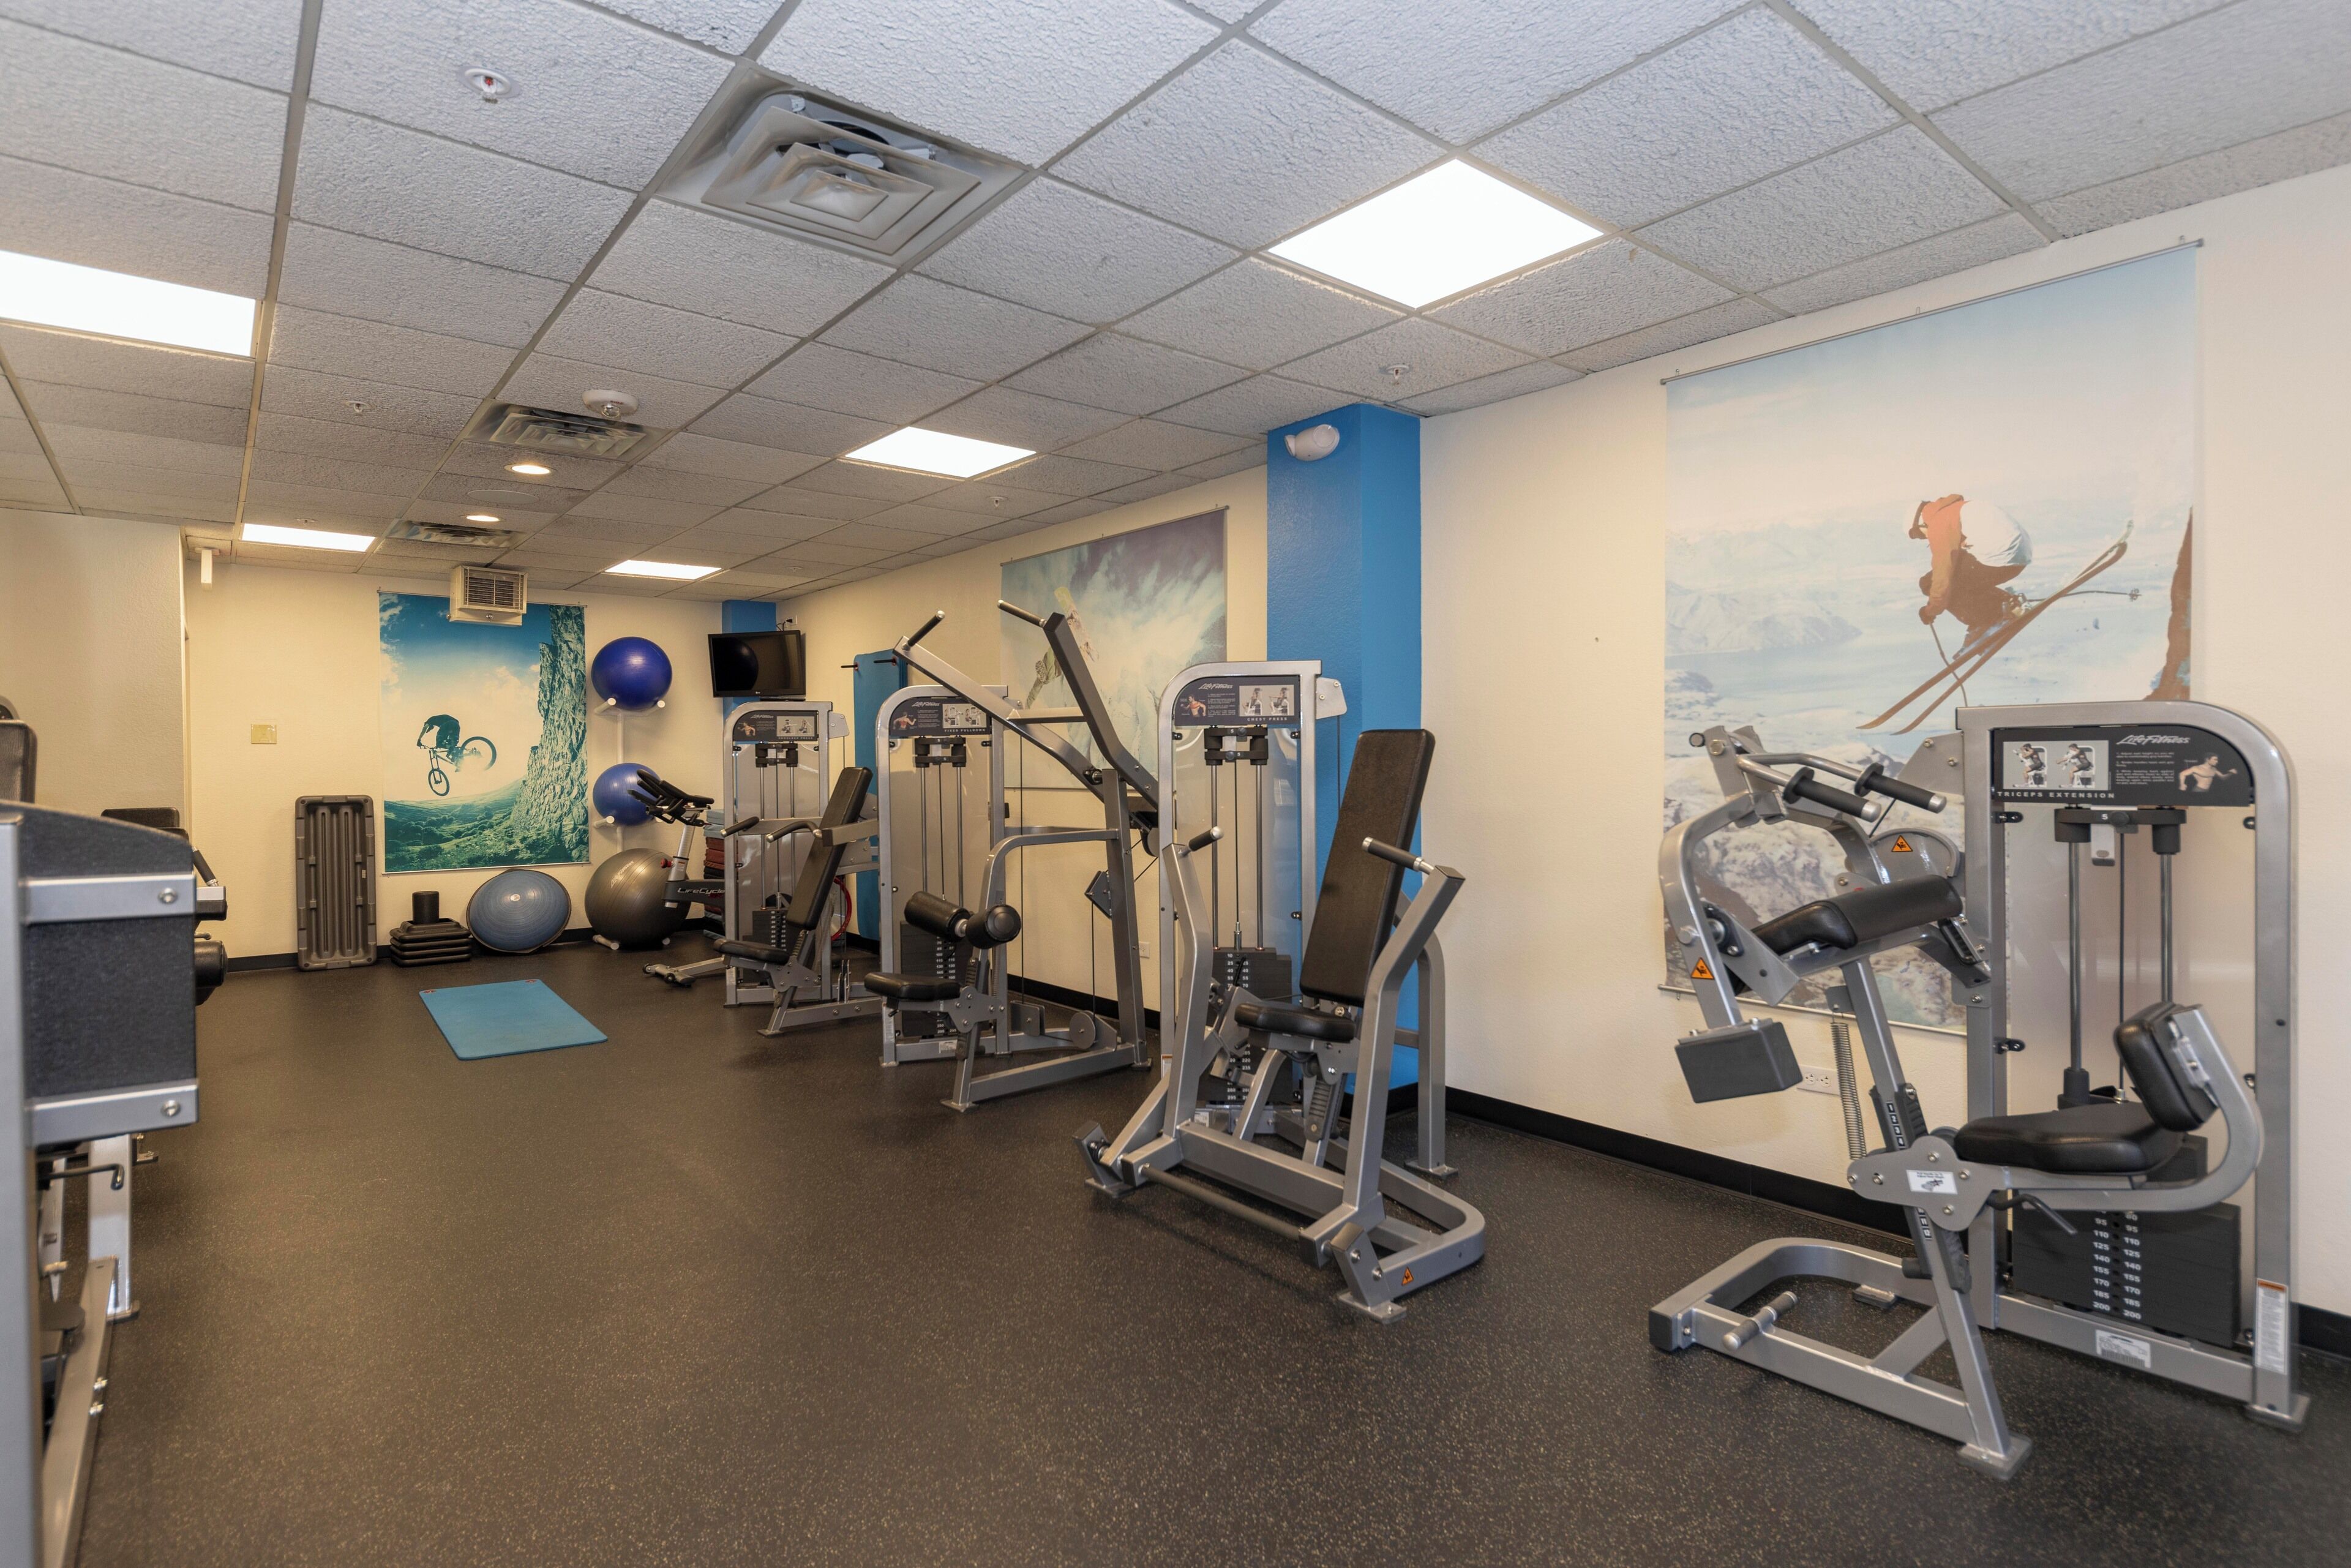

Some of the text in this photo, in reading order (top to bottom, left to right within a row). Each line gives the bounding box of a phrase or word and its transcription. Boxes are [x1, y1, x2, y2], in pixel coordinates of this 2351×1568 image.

[2094, 1217, 2138, 1233] 95 95
[2093, 1229, 2140, 1246] 110 110
[2093, 1242, 2140, 1258] 125 125
[2093, 1254, 2142, 1271] 140 140
[2092, 1266, 2140, 1283] 155 155
[2093, 1278, 2140, 1295] 170 170
[2093, 1289, 2140, 1307] 185 185
[2093, 1301, 2141, 1320] 200 200
